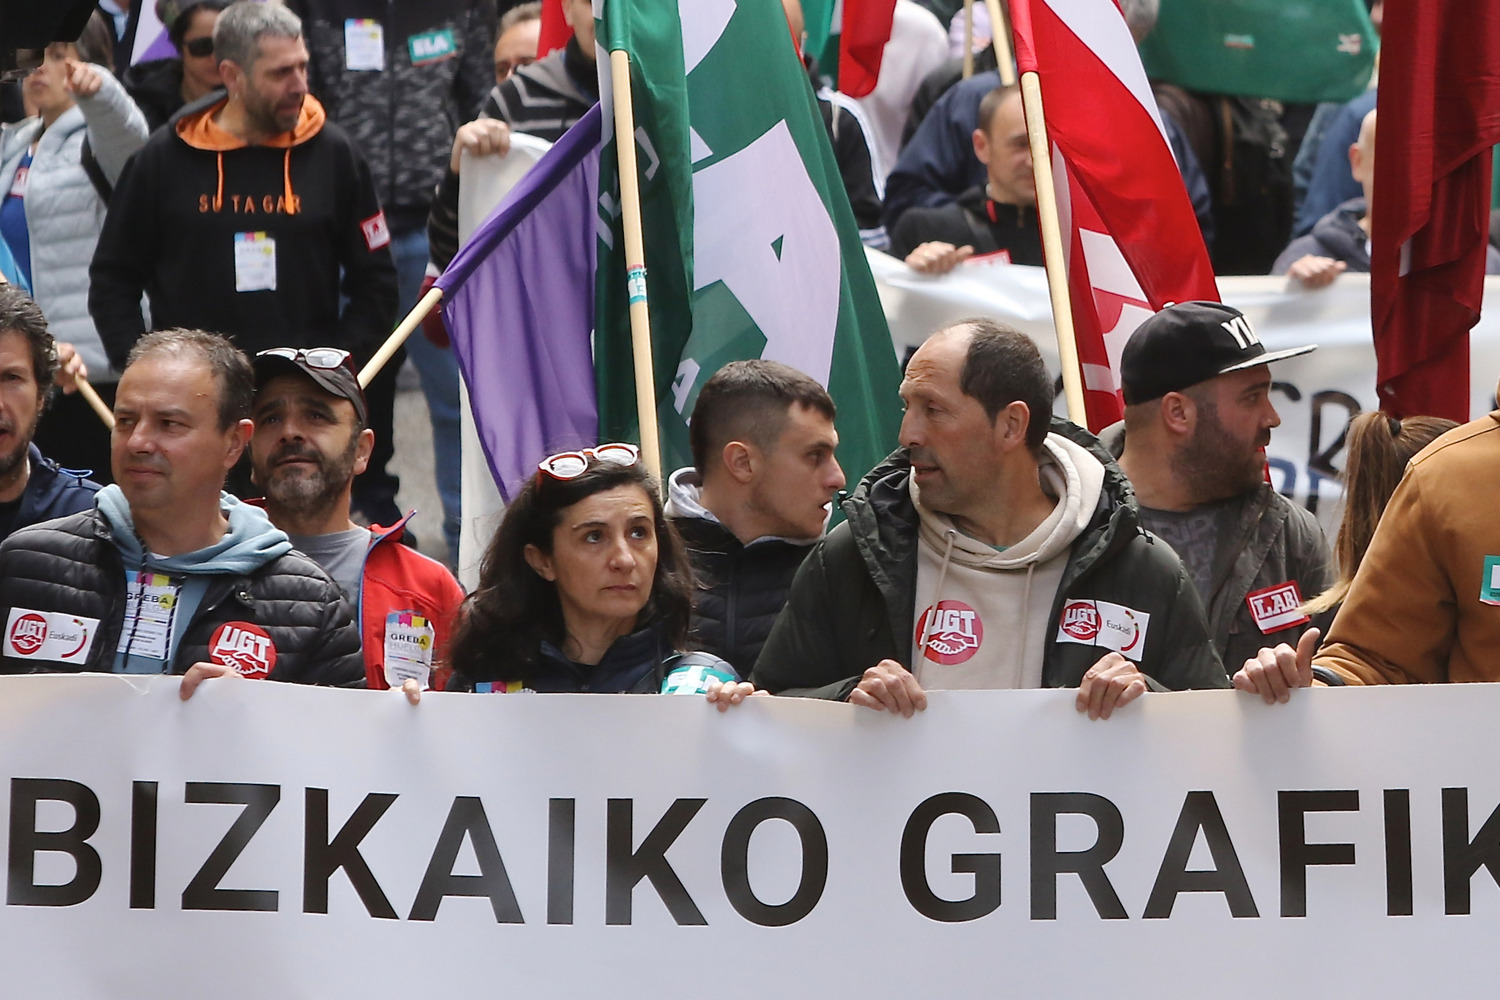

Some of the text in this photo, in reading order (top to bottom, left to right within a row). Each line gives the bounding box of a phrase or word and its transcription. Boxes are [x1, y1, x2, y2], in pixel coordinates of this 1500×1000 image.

[1254, 590, 1297, 618] LAB
[18, 618, 77, 643] UGT Euskadi
[924, 609, 975, 635] UGT
[1065, 608, 1132, 636] UGT Euskadi
[217, 625, 271, 660] UGT
[390, 633, 426, 646] GREBA
[390, 642, 425, 653] HUELG
[6, 777, 829, 928] BIZKAIKO
